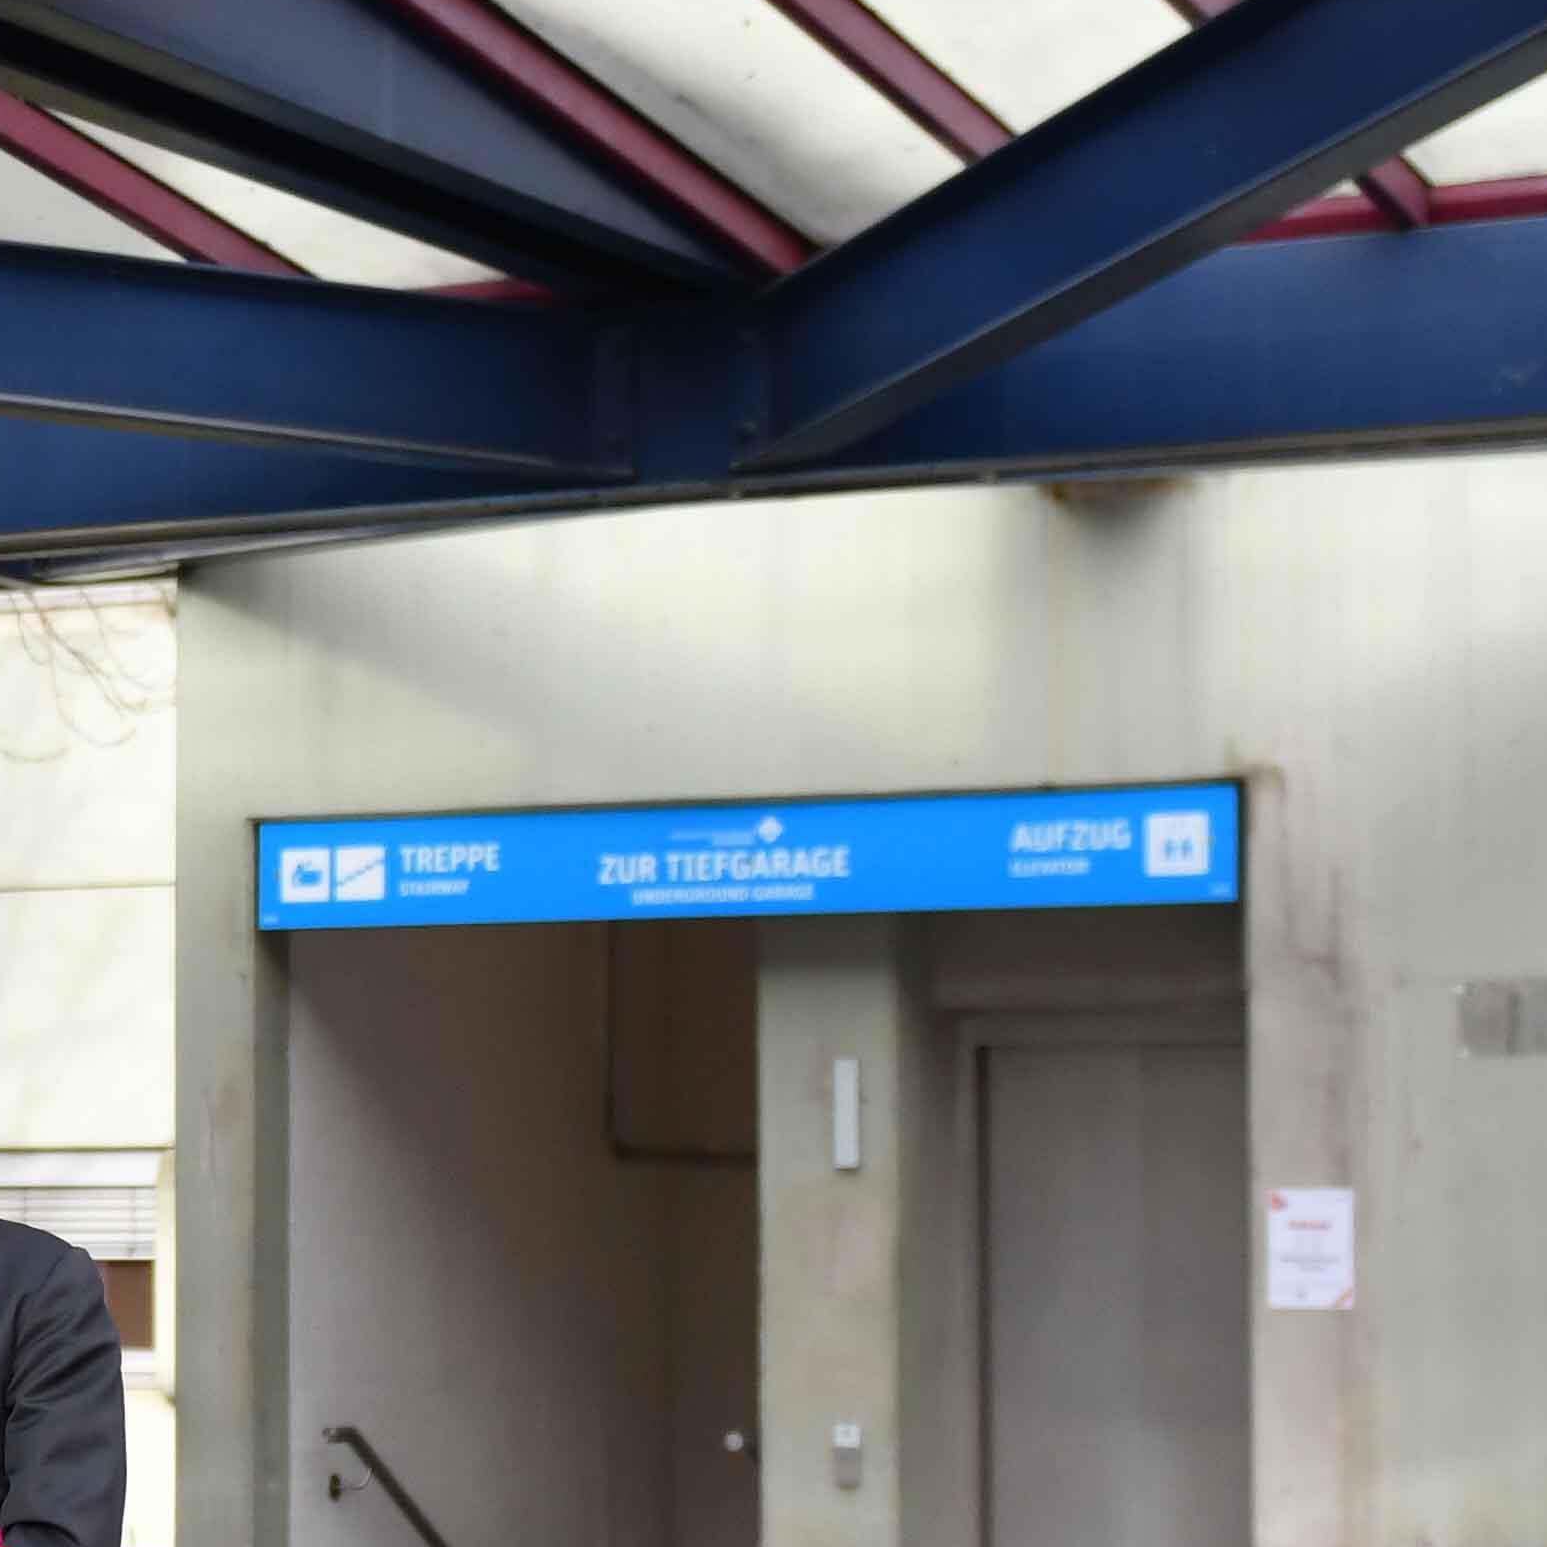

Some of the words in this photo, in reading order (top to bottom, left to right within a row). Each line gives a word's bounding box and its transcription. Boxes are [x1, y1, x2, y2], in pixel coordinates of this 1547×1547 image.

[1011, 817, 1132, 853] AUFZUG
[400, 841, 500, 873] TREPPE
[598, 854, 657, 885] ZUR
[667, 845, 850, 882] TIEFGARAGE
